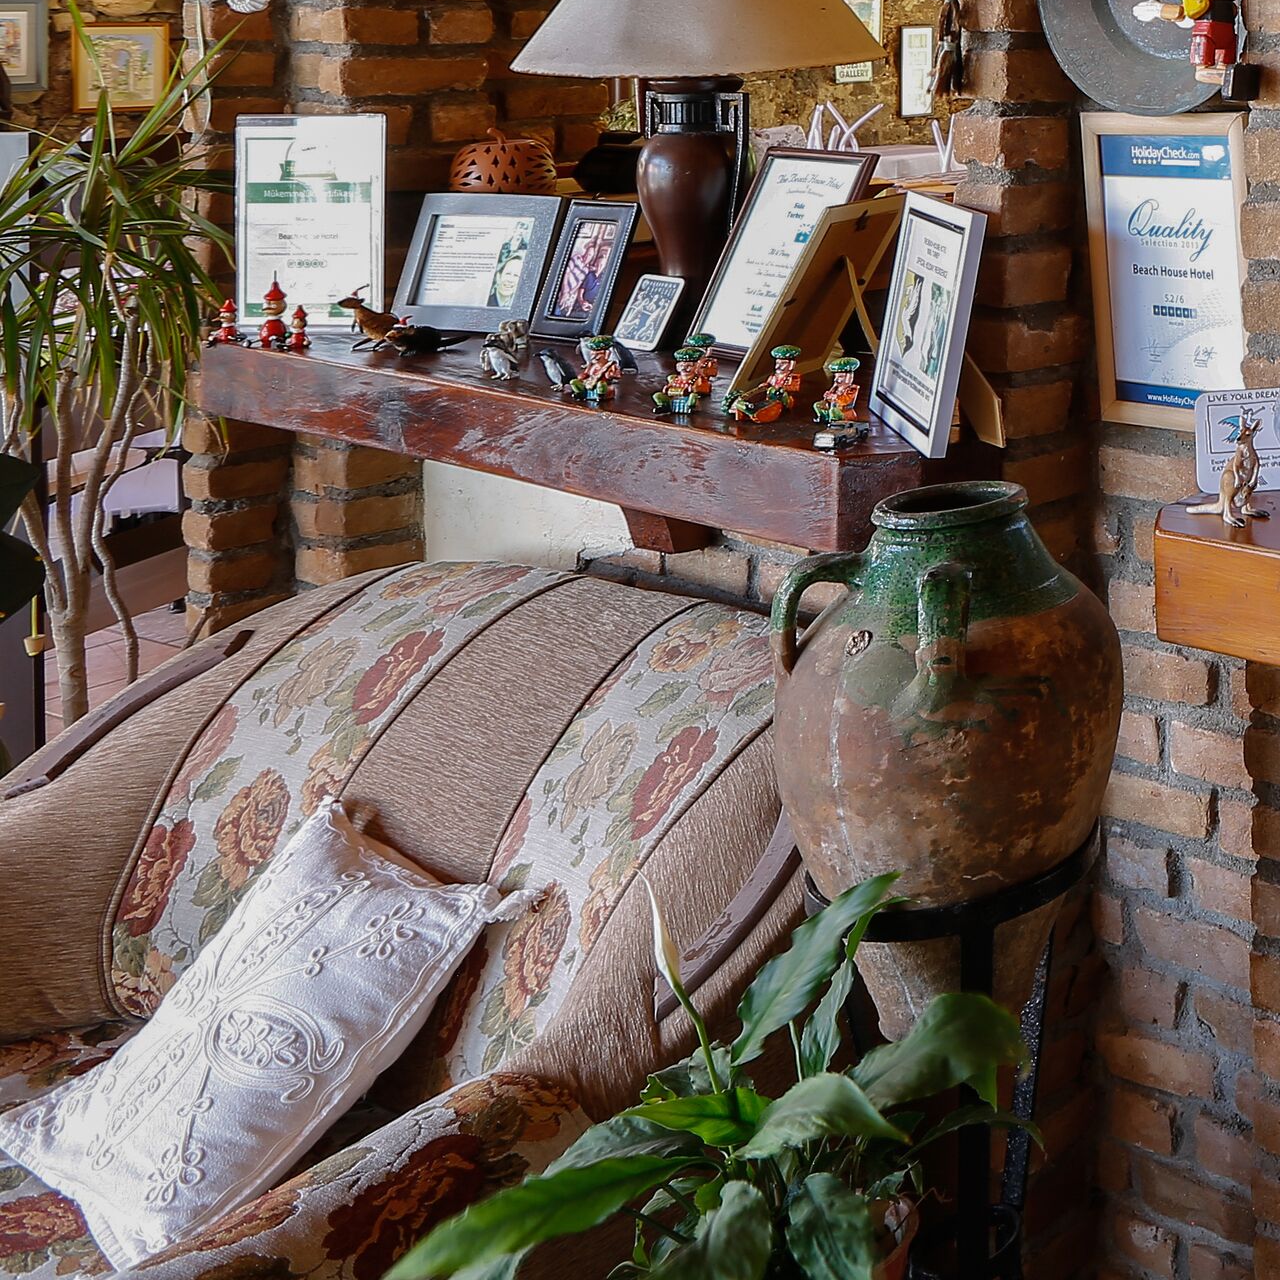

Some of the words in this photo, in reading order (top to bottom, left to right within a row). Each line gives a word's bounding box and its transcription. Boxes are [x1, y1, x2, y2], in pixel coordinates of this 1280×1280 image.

[839, 69, 869, 78] GALLERY
[1131, 146, 1200, 161] HolidayCheck.com
[1128, 199, 1214, 262] Quality
[1141, 239, 1178, 248] Selection
[1133, 264, 1159, 277] Beach
[1160, 266, 1188, 279] House
[1190, 268, 1214, 280] Hotel
[1208, 394, 1228, 402] LIVE
[1230, 392, 1253, 401] YOUR
